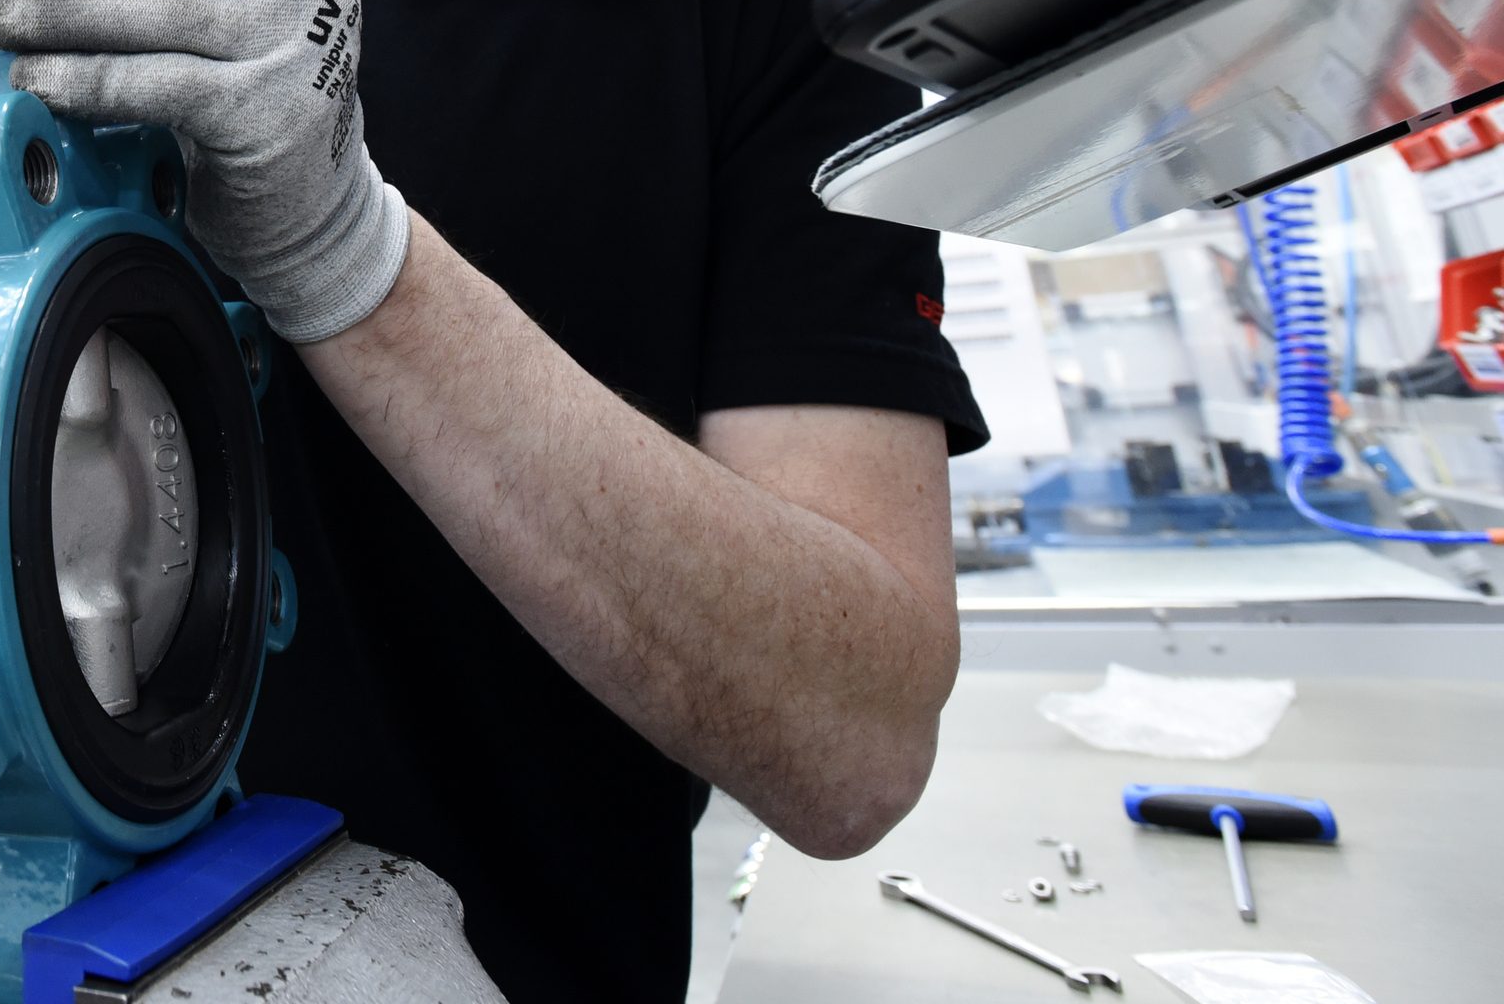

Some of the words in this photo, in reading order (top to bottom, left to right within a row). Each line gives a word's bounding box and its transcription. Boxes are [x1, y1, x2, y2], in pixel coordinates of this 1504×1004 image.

[313, 29, 347, 91] unipur
[327, 78, 342, 99] EN
[339, 52, 353, 78] 388
[150, 412, 191, 575] 1.4408
